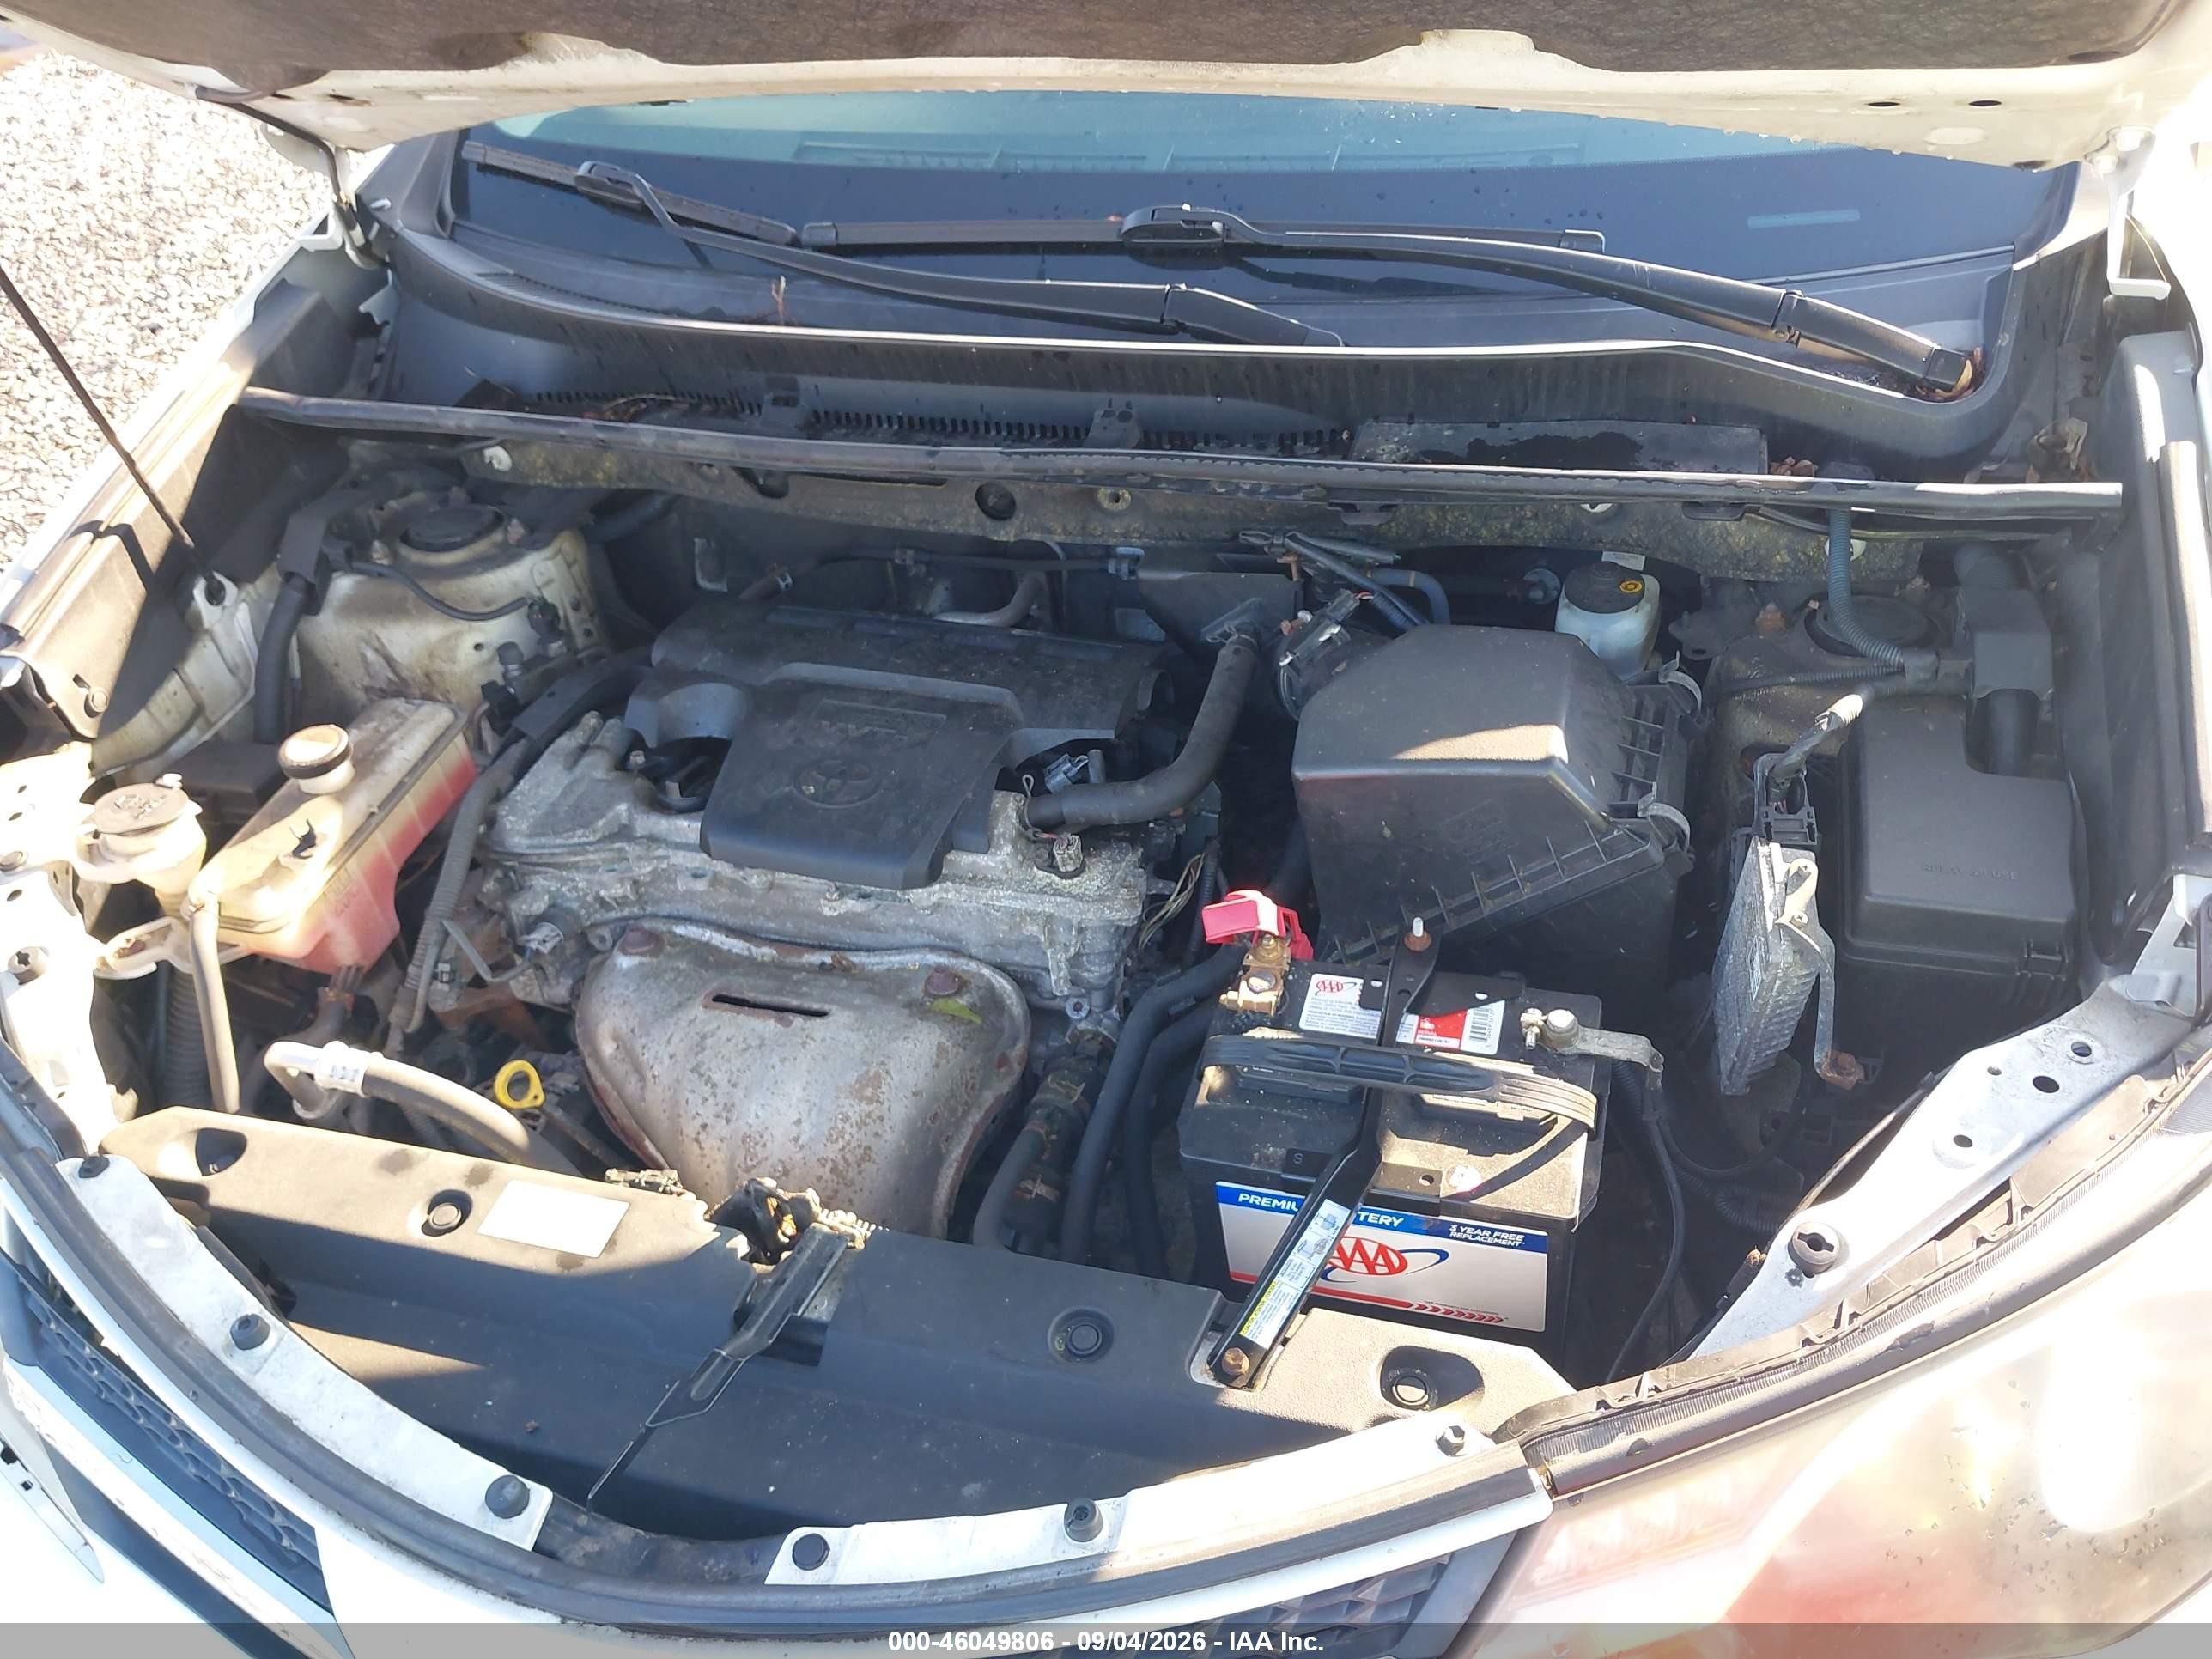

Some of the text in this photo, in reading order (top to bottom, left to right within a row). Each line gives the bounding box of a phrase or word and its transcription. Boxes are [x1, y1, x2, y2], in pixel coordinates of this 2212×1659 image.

[1293, 1152, 1304, 1164] S
[1238, 1193, 1404, 1227] PREMI TERY
[1460, 1225, 1492, 1237] YEAR
[1492, 1231, 1525, 1242] FREE
